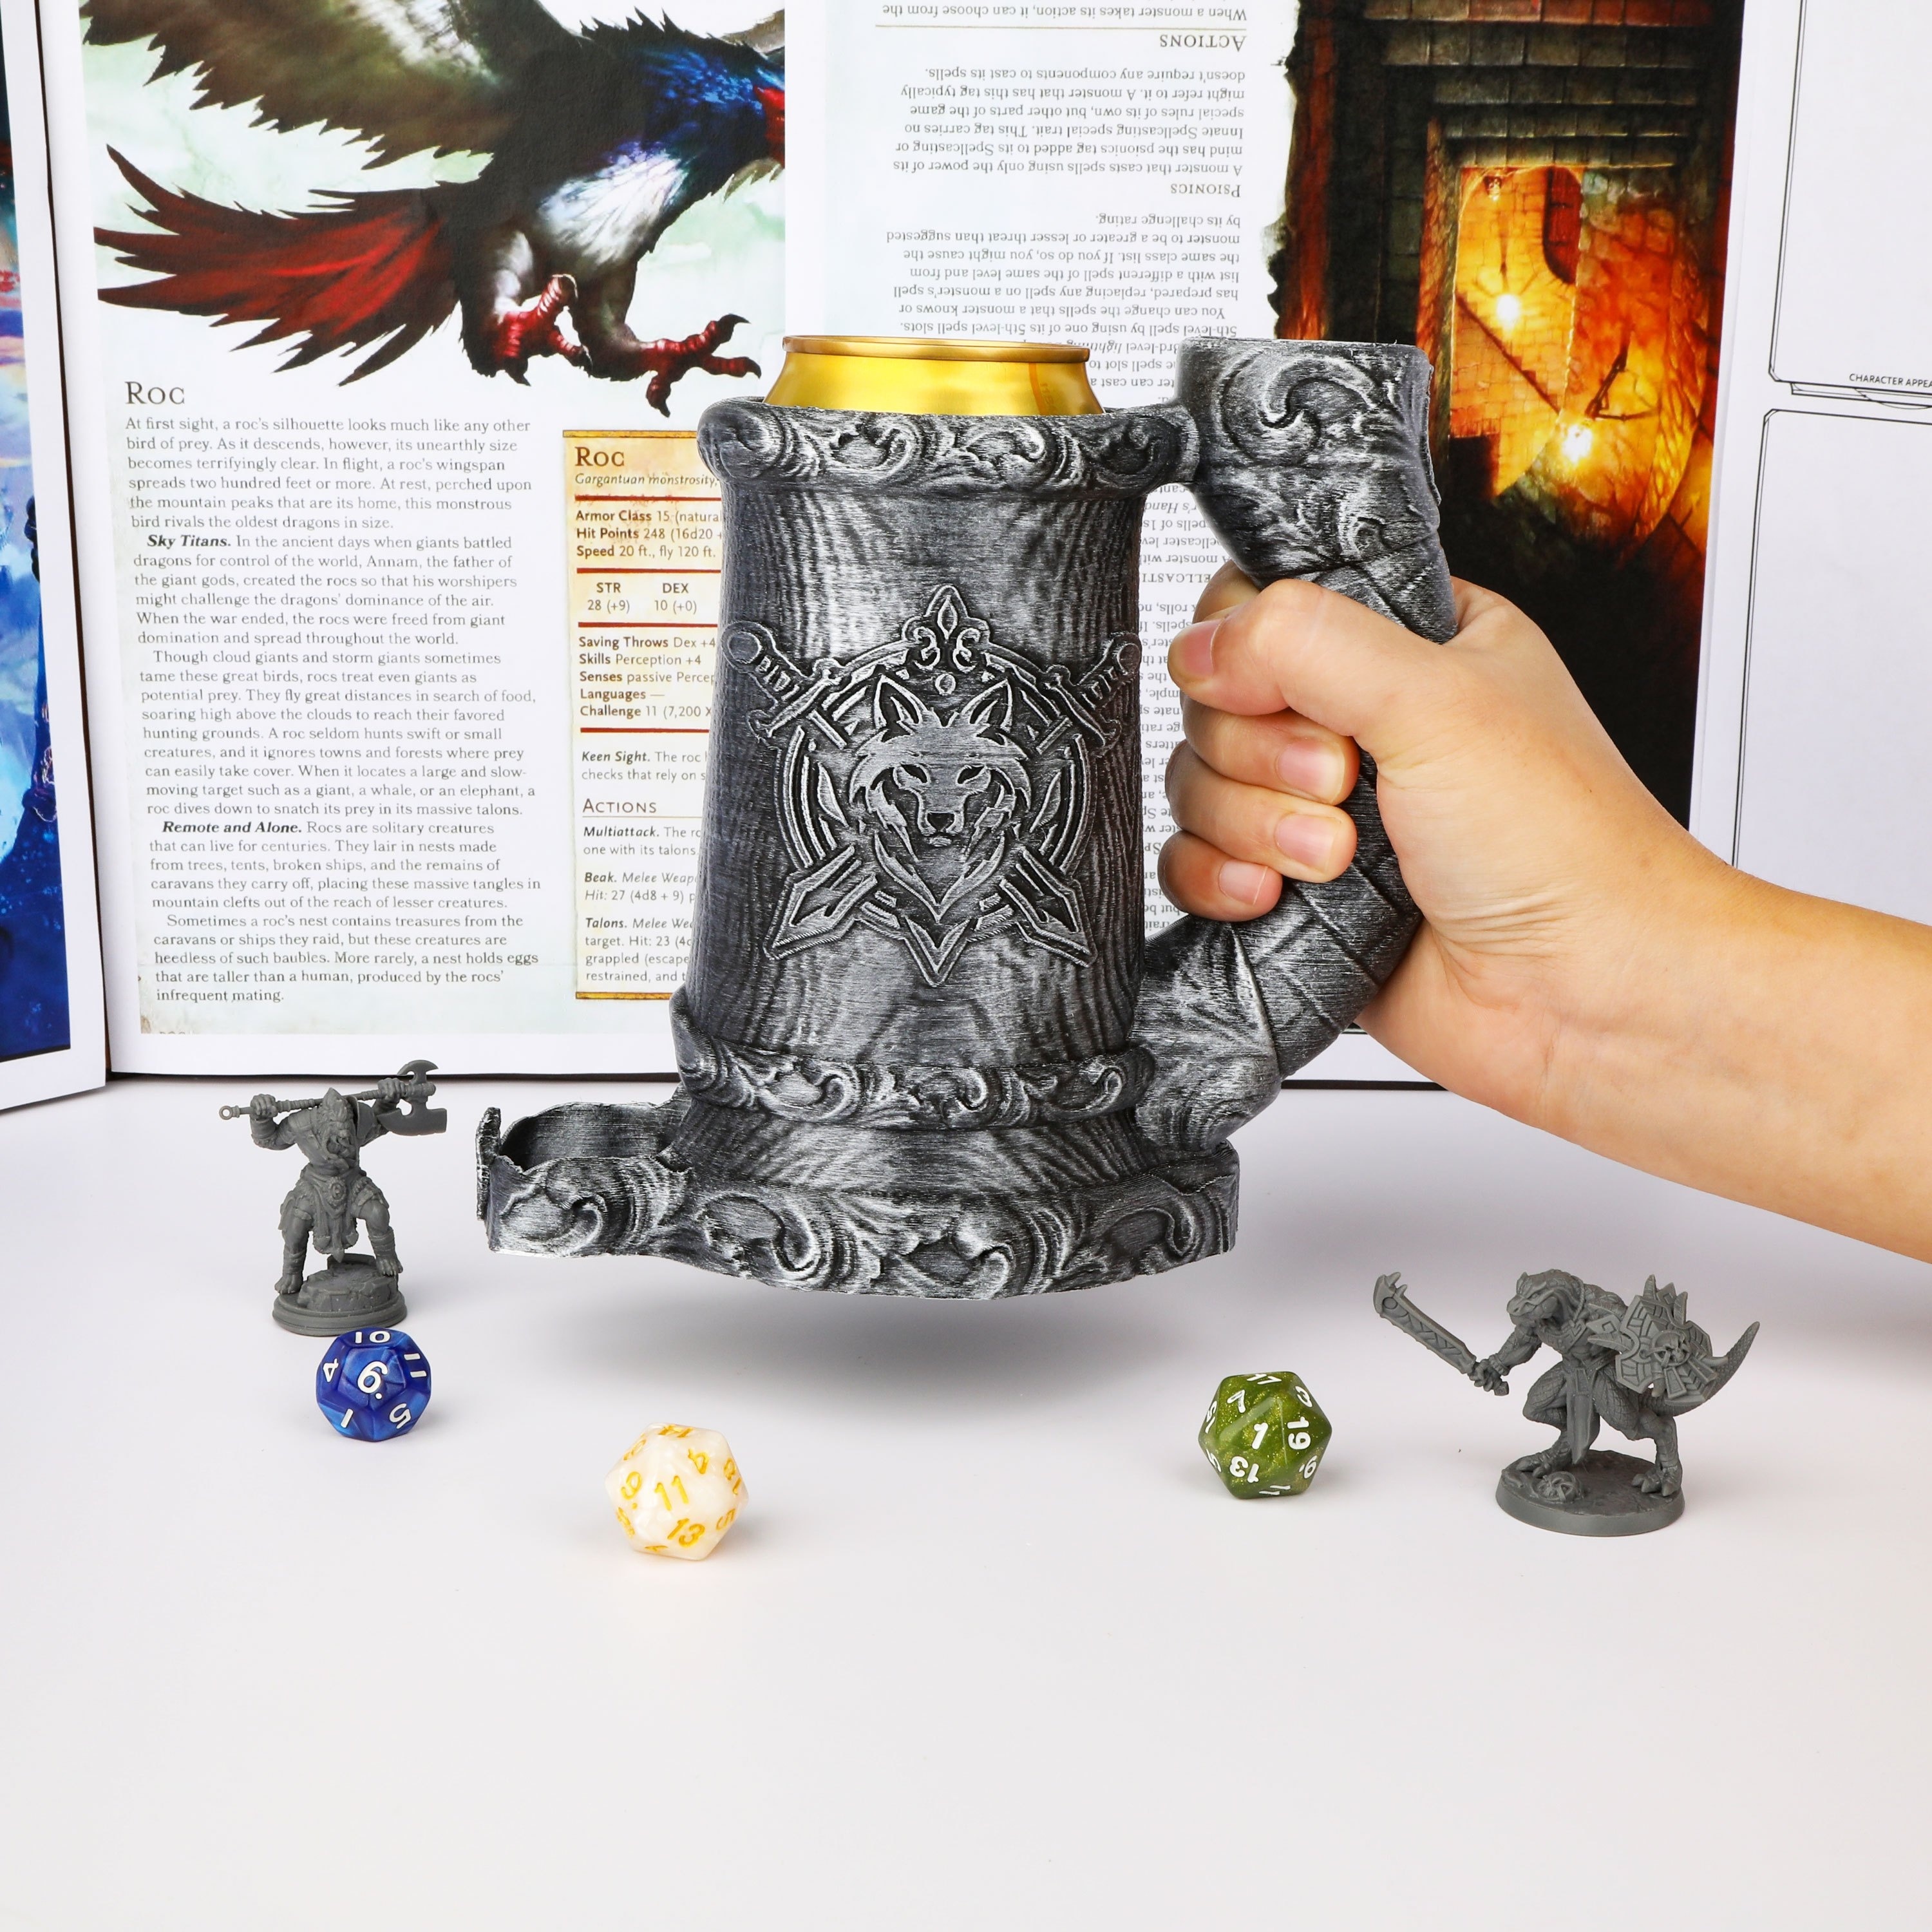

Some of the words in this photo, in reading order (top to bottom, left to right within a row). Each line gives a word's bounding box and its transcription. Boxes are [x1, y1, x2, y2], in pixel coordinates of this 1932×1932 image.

[883, 5, 902, 17] the
[908, 6, 938, 17] from
[943, 6, 989, 17] choose
[1021, 7, 1028, 18] it
[1034, 6, 1076, 18] action,
[1081, 8, 1095, 19] its
[1100, 8, 1134, 19] takes
[1139, 8, 1192, 17] monster
[1209, 8, 1246, 21] When
[894, 162, 908, 172] its
[912, 162, 924, 173] of
[929, 160, 968, 170] power
[973, 162, 992, 173] the
[998, 160, 1024, 174] only
[1028, 160, 1063, 174] using
[1068, 161, 1105, 175] spells
[1110, 164, 1142, 173] casts
[1147, 164, 1171, 175] that
[1175, 164, 1228, 173] monster
[1233, 166, 1242, 176] A
[1849, 373, 1904, 385] CHARACTER
[126, 417, 140, 429] At
[147, 417, 174, 429] first
[180, 417, 218, 432] sight,
[223, 421, 230, 430] a
[236, 417, 268, 430] roc's
[274, 418, 343, 430] silhouette
[349, 419, 386, 430] looks
[391, 419, 429, 431] much
[435, 419, 459, 431] like
[464, 423, 489, 434] any
[493, 419, 530, 431] other
[575, 473, 645, 488] Gargantuan
[576, 510, 615, 522] Armor
[618, 509, 652, 522] Class
[658, 511, 669, 522] 15
[576, 527, 596, 539] Hit
[600, 527, 639, 540] Points
[644, 528, 665, 540] 248
[671, 527, 712, 542] (16d20
[147, 535, 176, 549] Sky
[180, 535, 231, 547] Titans.
[236, 535, 250, 547] In
[256, 536, 277, 547] the
[283, 536, 333, 547] ancient
[338, 536, 370, 550] days
[374, 536, 412, 547] when
[417, 536, 459, 551] giants
[464, 536, 511, 549] battled
[577, 545, 614, 560] Speed
[620, 545, 634, 556] 20
[638, 544, 654, 558] ft.,
[659, 545, 673, 560] fly
[678, 546, 699, 556] 120
[703, 545, 715, 557] ft.
[596, 582, 621, 593] STR
[663, 583, 688, 593] DEX
[588, 600, 601, 611] 28
[607, 600, 629, 614] (+9)
[655, 600, 667, 611] 10
[673, 601, 696, 614] (+0)
[579, 636, 620, 650] Saving
[623, 636, 668, 647] Throws
[674, 637, 696, 647] Dex
[701, 638, 715, 647] +4
[580, 652, 611, 664] Skills
[616, 654, 681, 668] Perception
[686, 655, 701, 665] +4
[580, 671, 623, 681] Senses
[627, 672, 672, 685] passive
[581, 688, 646, 703] Languages
[580, 704, 641, 719] Challenge
[647, 706, 656, 716] 11
[664, 706, 701, 719] (7,200
[582, 752, 611, 761] Keen
[615, 750, 650, 765] Sight.
[655, 751, 677, 762] The
[582, 768, 623, 780] checks
[628, 768, 651, 780] that
[656, 769, 676, 783] rely
[162, 821, 220, 833] Remote
[224, 821, 251, 833] and
[255, 821, 302, 833] Alone.
[307, 821, 342, 833] Rocs
[373, 822, 424, 835] solitary
[429, 822, 495, 833] creatures
[583, 826, 659, 837] Multiattack.
[664, 827, 686, 837] The
[610, 844, 635, 855] with
[641, 845, 654, 855] its
[585, 871, 616, 882] Beak.
[623, 872, 656, 882] Melee
[585, 890, 607, 900] Hit:
[612, 890, 625, 900] 27
[630, 889, 656, 904] (4d8
[673, 891, 683, 904] 9)
[585, 917, 627, 928] Talons.
[633, 918, 667, 928] Melee
[585, 937, 623, 949] target.
[630, 936, 651, 946] Hit:
[656, 936, 670, 946] 23
[586, 952, 639, 967] grappled
[587, 971, 650, 982] restrained,
[656, 971, 677, 981] and
[157, 989, 228, 1003] infrequent
[232, 989, 283, 1003] mating.
[355, 1331, 391, 1343] 10
[323, 1358, 339, 1382] 4
[1227, 1390, 1246, 1413] 7
[389, 1403, 411, 1429] 5
[1251, 1422, 1269, 1449] 1
[1287, 1416, 1311, 1450] 19
[1229, 1455, 1260, 1483] 13
[654, 1475, 689, 1511] 11
[667, 1518, 706, 1548] 13
